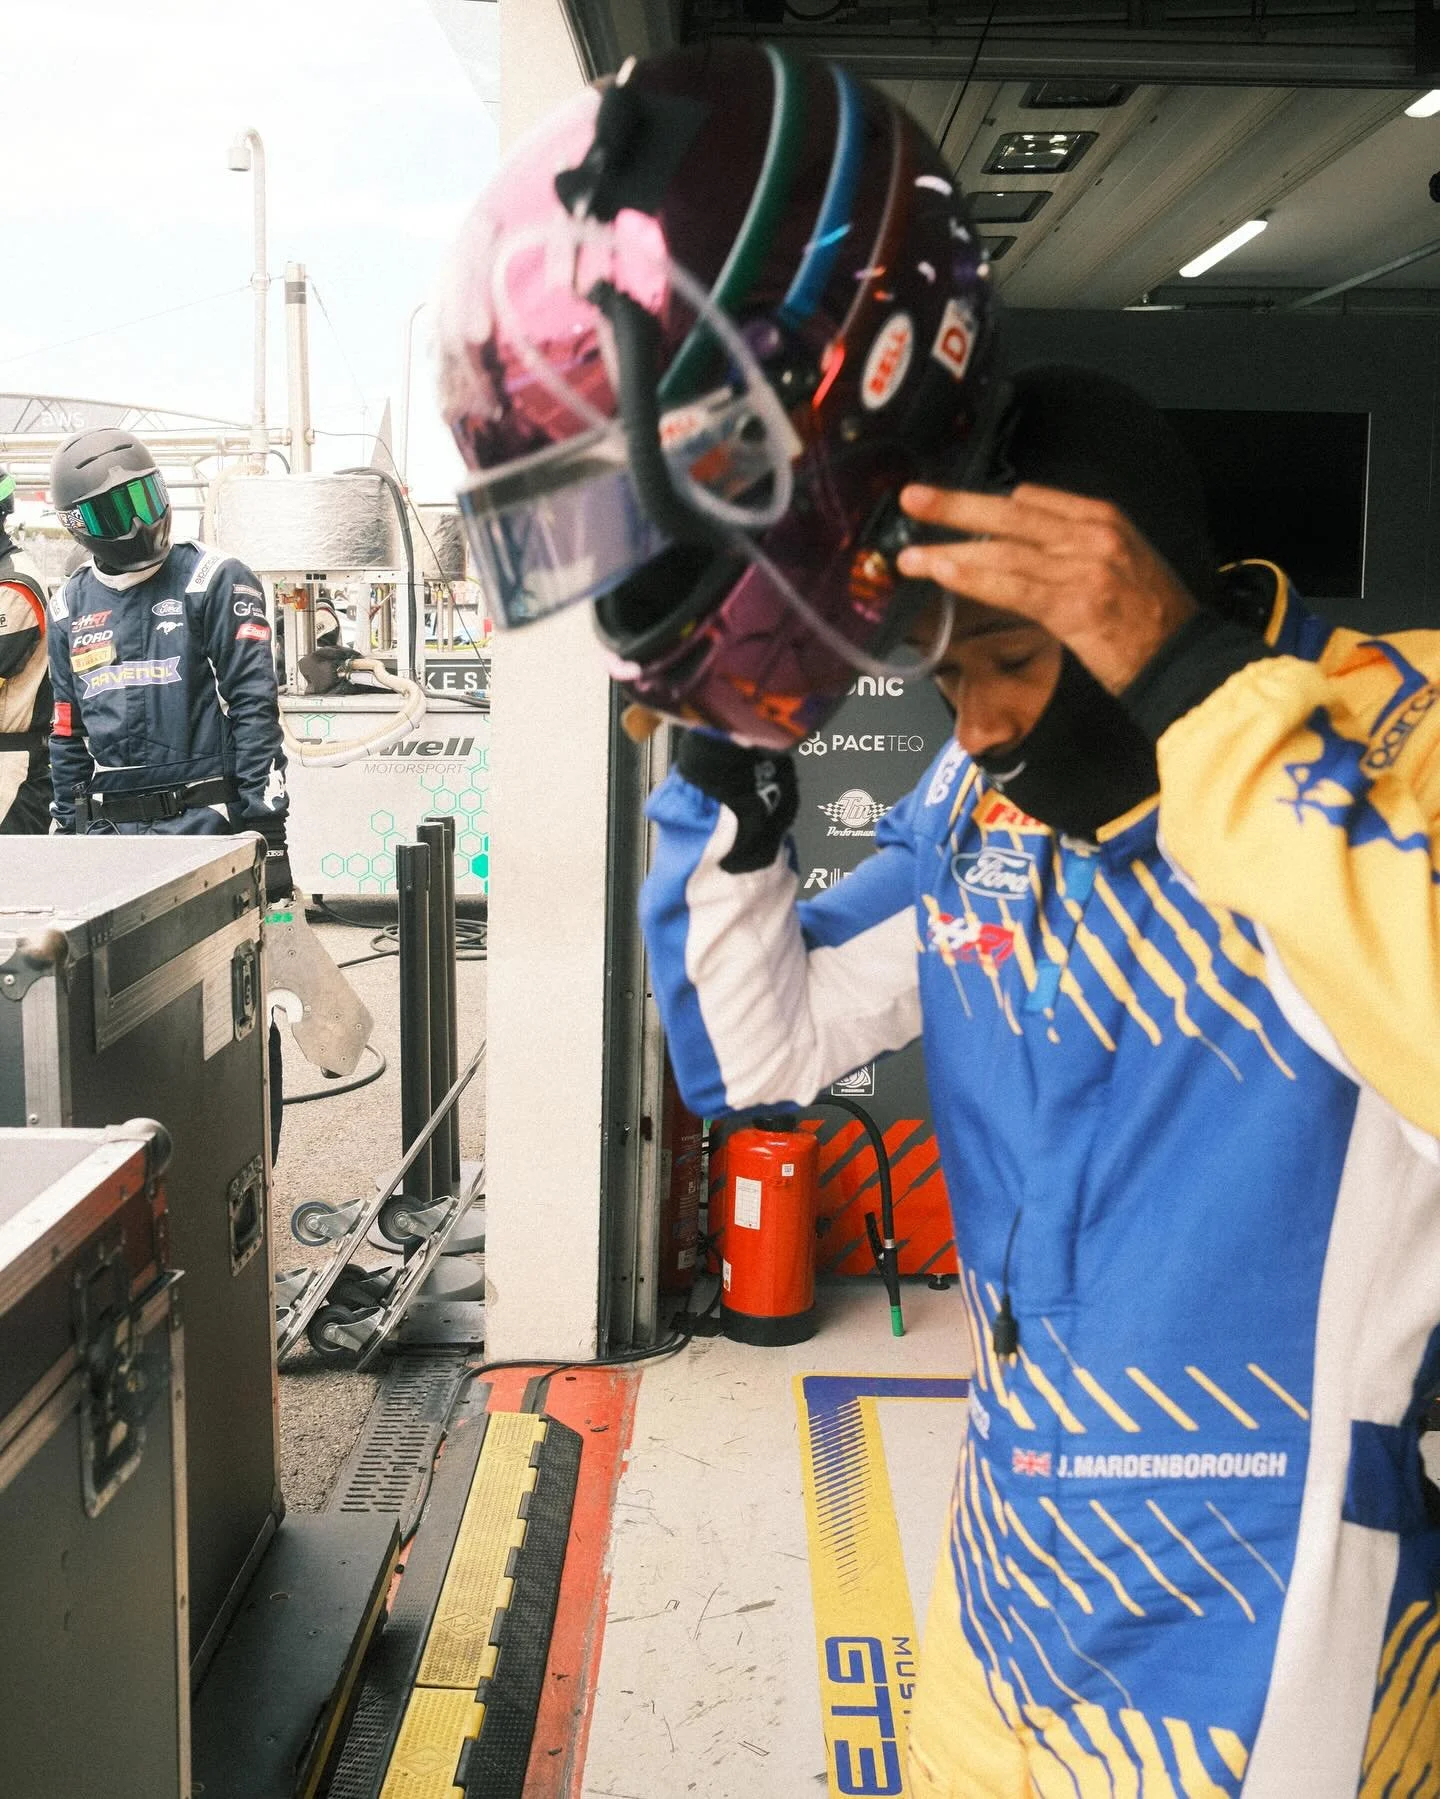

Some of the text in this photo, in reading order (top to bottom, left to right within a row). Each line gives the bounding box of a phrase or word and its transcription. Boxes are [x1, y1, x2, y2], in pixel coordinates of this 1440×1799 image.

[73, 630, 114, 648] FORD
[90, 665, 174, 690] RAVENOL
[425, 671, 491, 692] KES
[831, 734, 925, 753] PACETEQ
[363, 763, 465, 775] MOTORSPORT
[826, 826, 878, 837] Performan
[1057, 1451, 1288, 1479] J.MARDENBOROUGH
[891, 1636, 917, 1715] MUS
[824, 1636, 904, 1796] GT3
